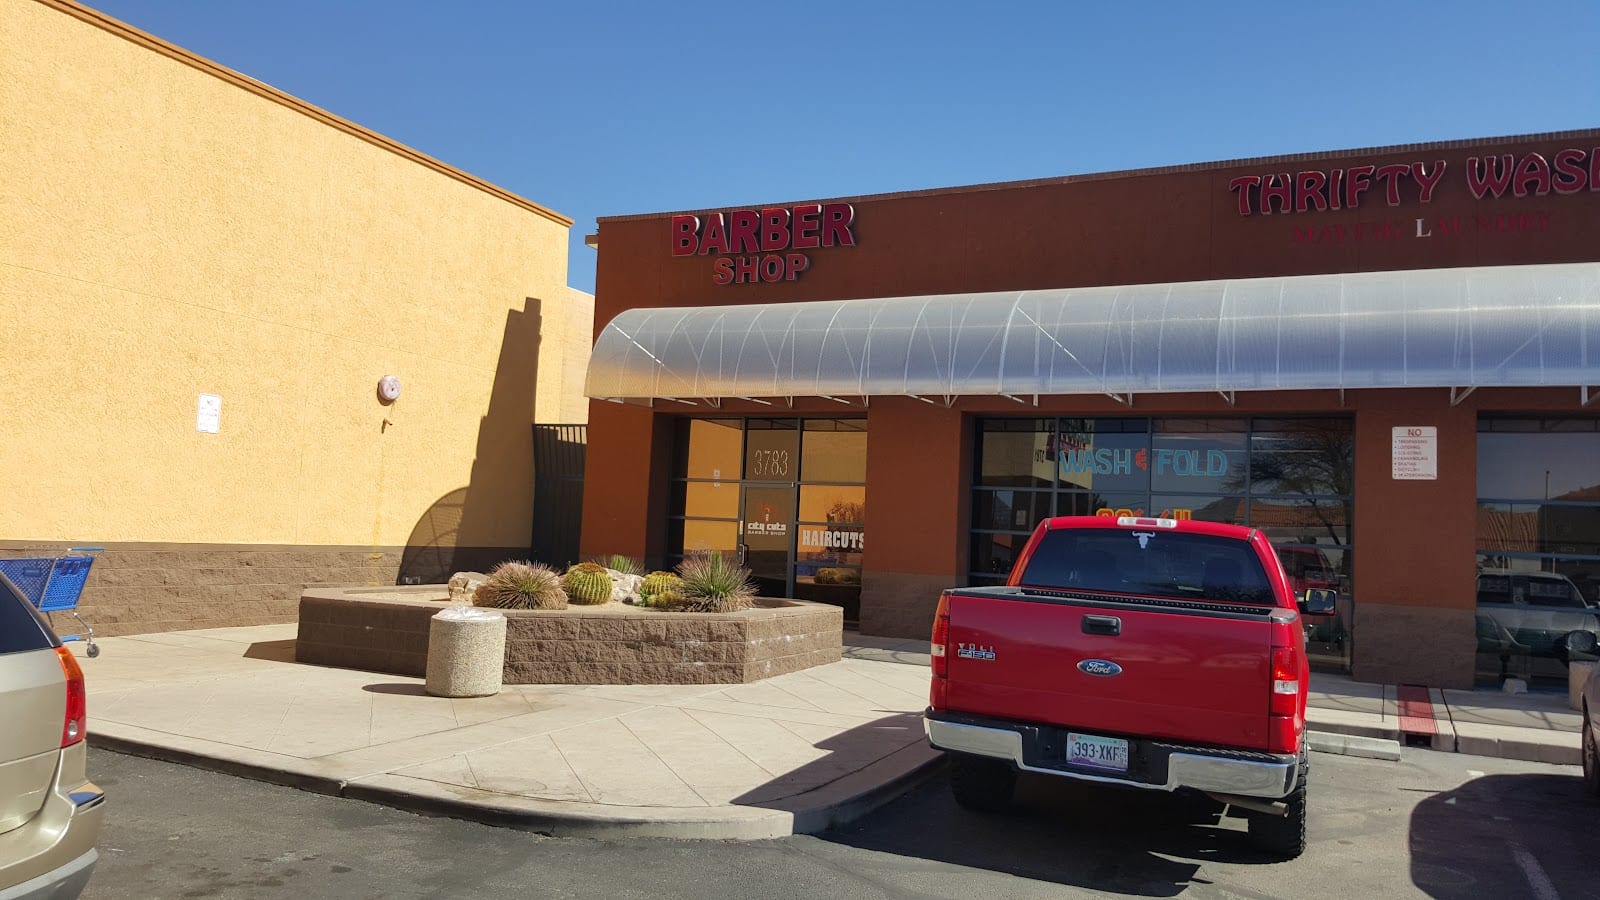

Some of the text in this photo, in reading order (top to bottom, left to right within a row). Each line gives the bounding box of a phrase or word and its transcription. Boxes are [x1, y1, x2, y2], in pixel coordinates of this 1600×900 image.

[1229, 160, 1447, 215] THRIFTY
[671, 203, 855, 257] BARBER
[712, 253, 808, 285] SHOP
[1407, 428, 1422, 436] NO
[754, 450, 789, 476] 3783
[1059, 449, 1131, 475] WASH
[1157, 449, 1228, 476] FOLD
[748, 521, 787, 533] city cuts
[802, 529, 864, 549] HAIRCUTS
[1086, 661, 1111, 674] Ford
[1074, 741, 1120, 761] 393-XKF
